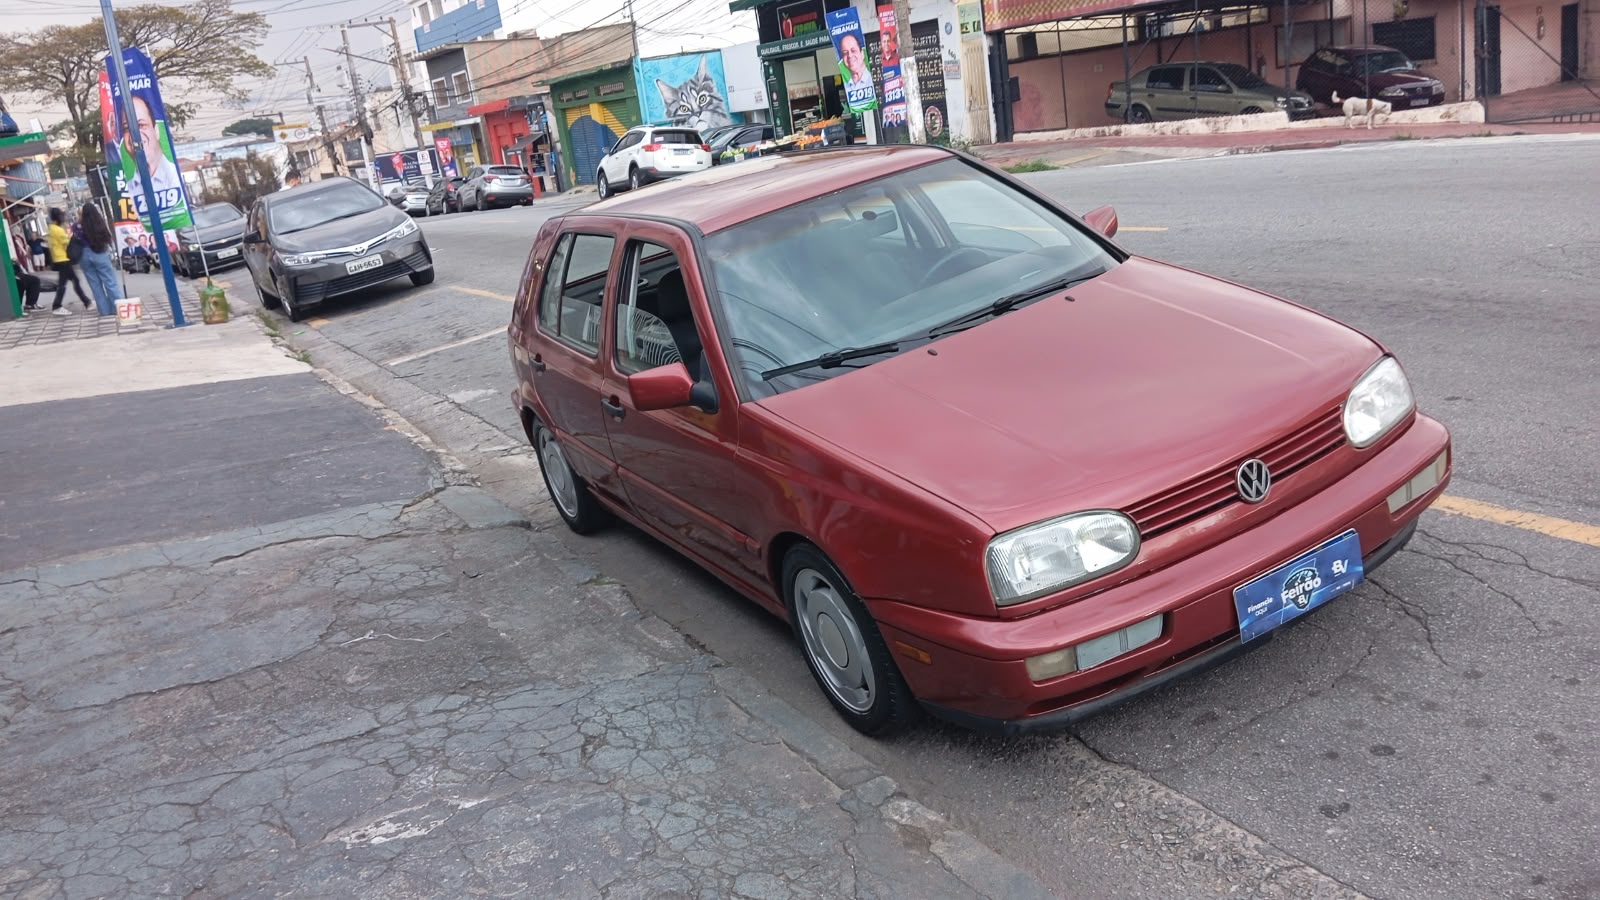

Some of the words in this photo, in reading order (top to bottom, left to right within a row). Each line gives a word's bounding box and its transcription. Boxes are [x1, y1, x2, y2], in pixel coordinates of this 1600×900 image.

[850, 87, 873, 101] 2019
[1280, 576, 1322, 604] Feirão
[1247, 596, 1274, 614] Financie
[1255, 606, 1268, 617] aqui
